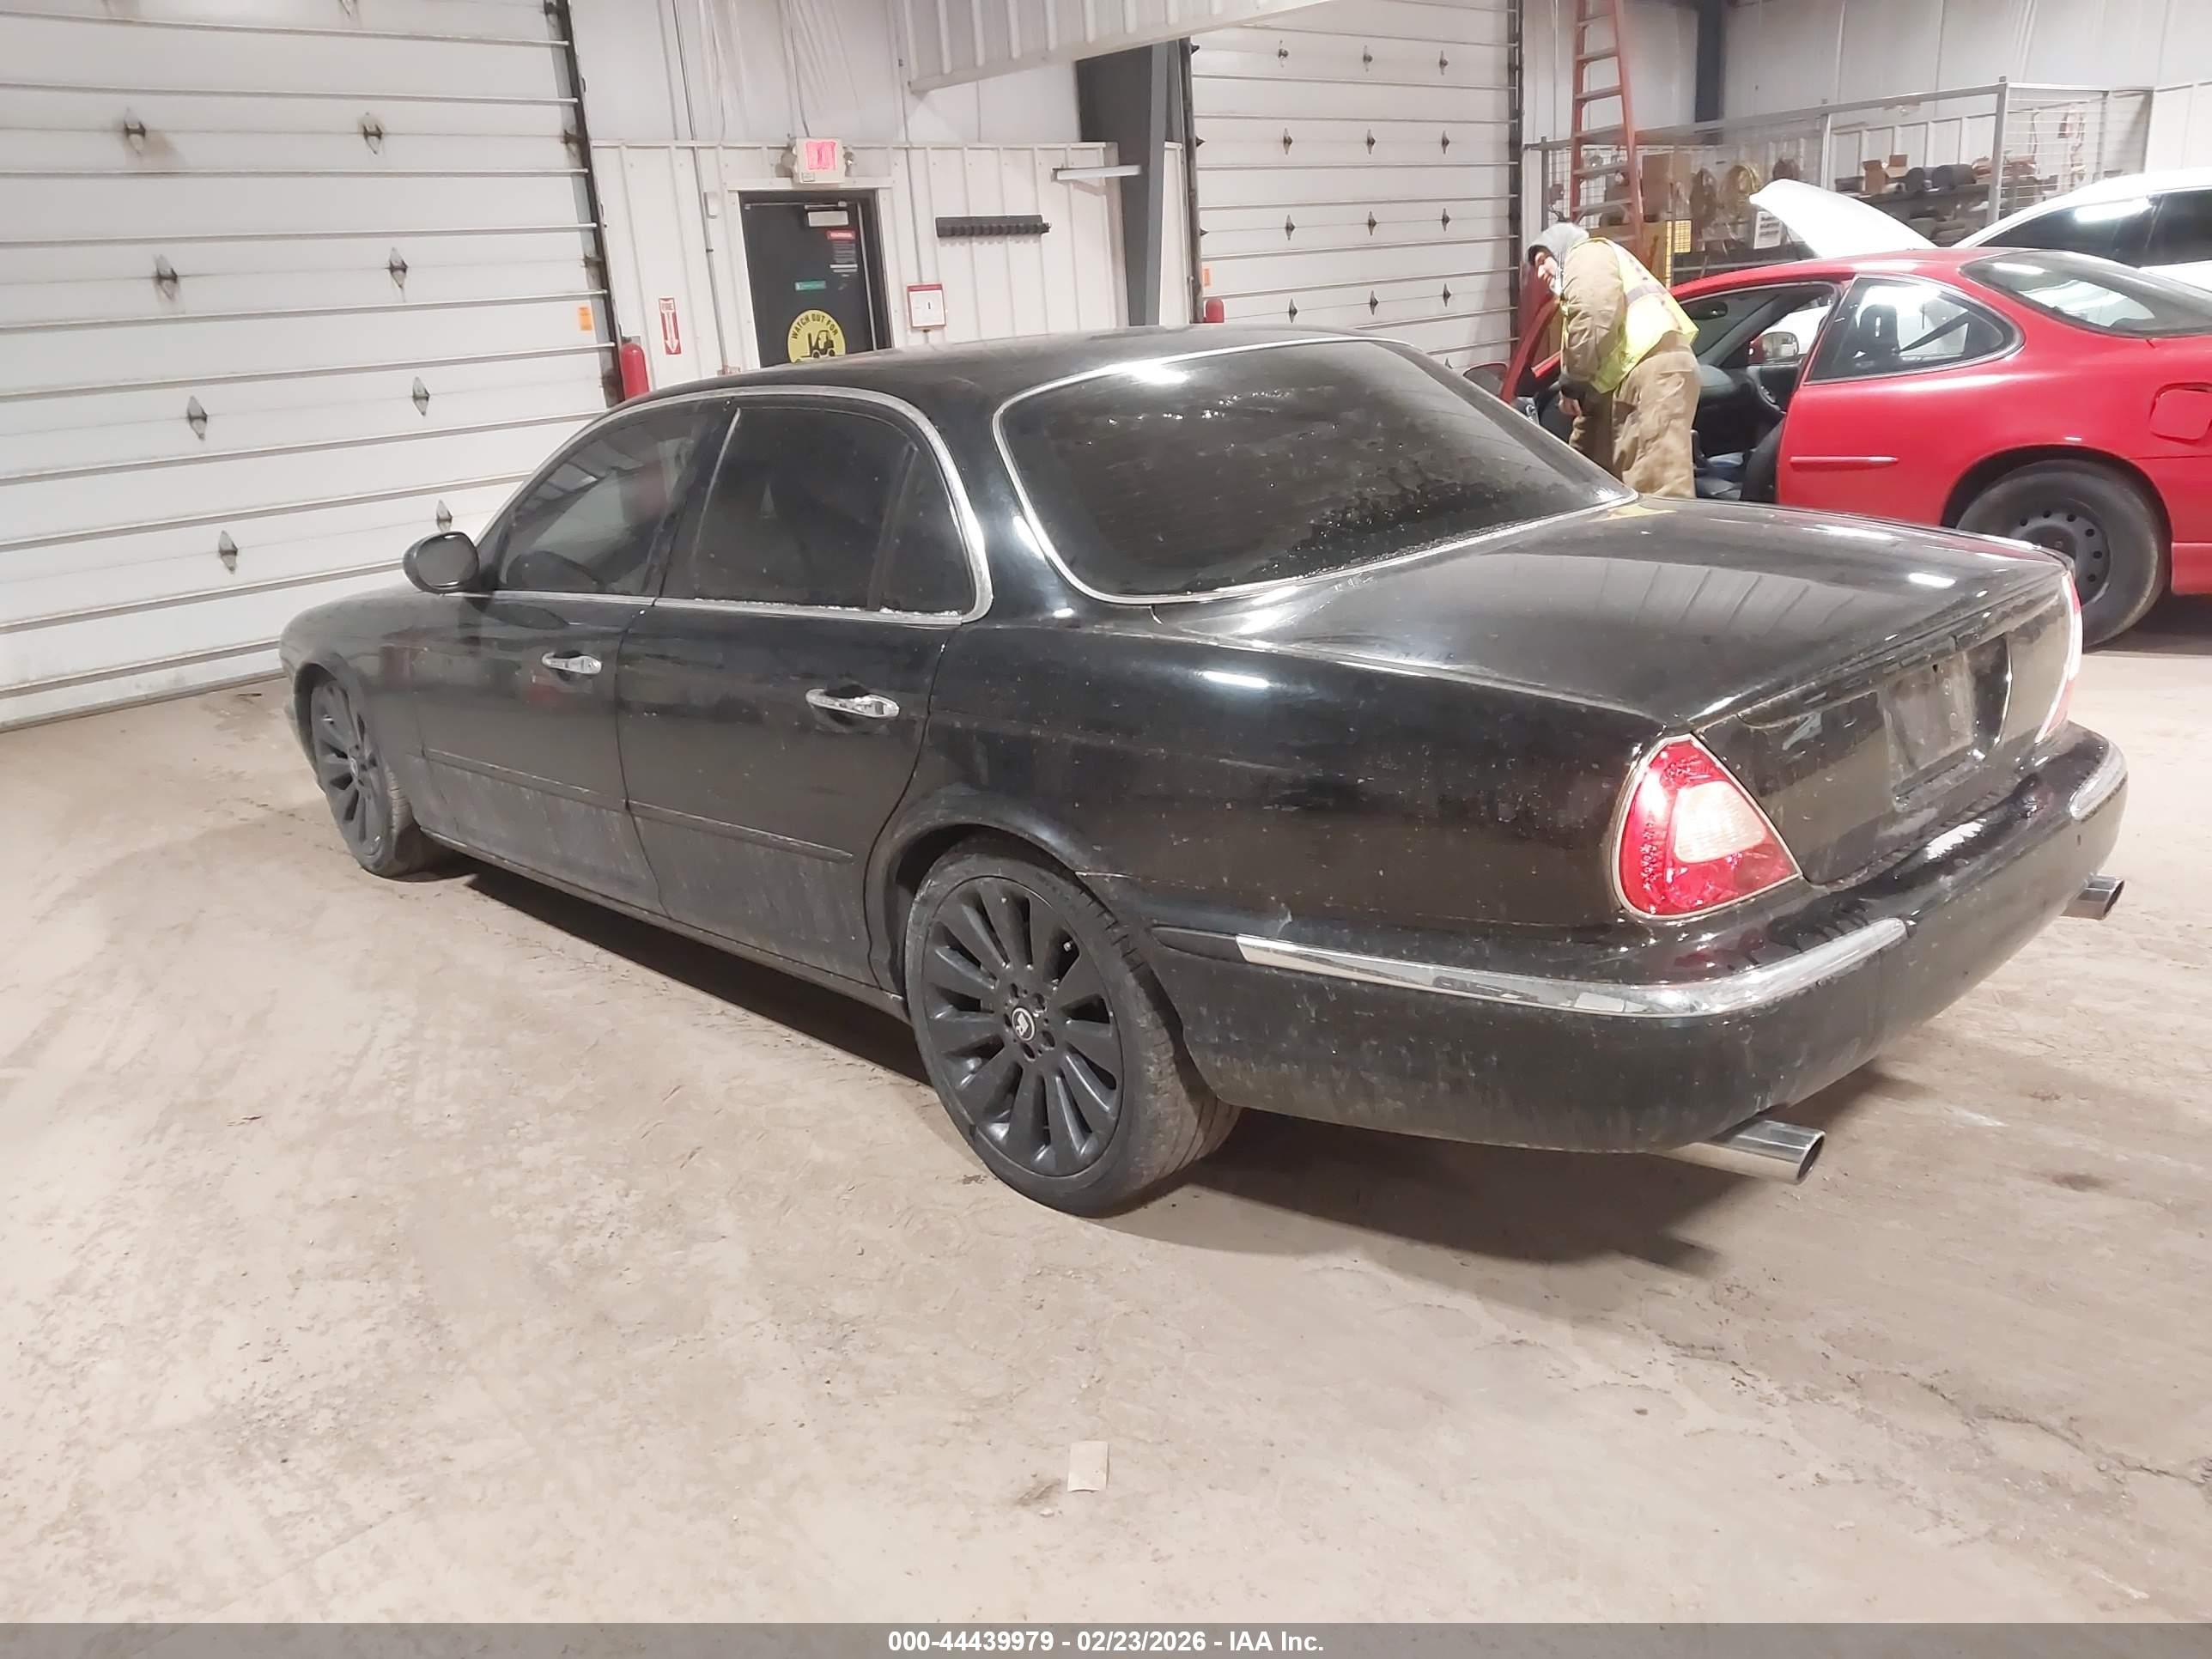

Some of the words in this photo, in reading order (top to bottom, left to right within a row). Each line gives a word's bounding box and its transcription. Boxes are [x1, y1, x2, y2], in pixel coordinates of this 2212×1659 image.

[791, 314, 811, 340] WATCH
[811, 313, 826, 324] OUT
[826, 319, 839, 336] FOR
